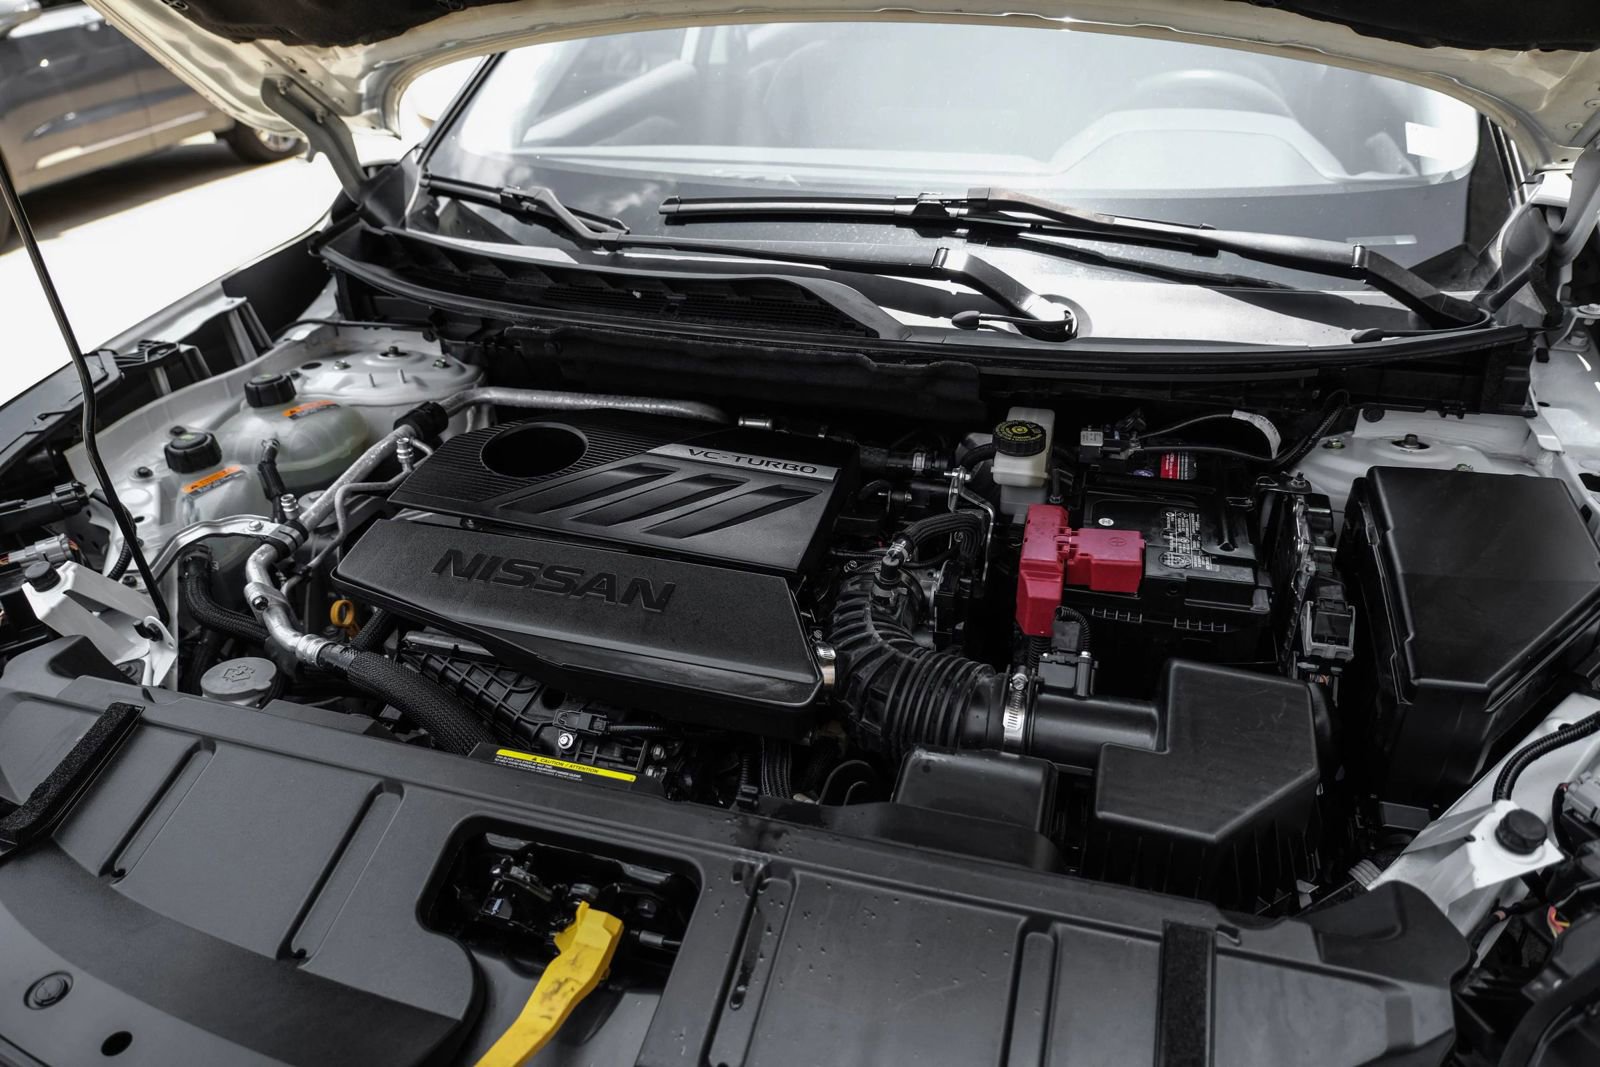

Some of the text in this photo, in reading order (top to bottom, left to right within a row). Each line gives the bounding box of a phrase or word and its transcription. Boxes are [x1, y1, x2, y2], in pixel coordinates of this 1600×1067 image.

[688, 448, 818, 475] VC-TURBO
[431, 549, 676, 613] NISSAN
[540, 758, 564, 767] CAUTION
[569, 764, 599, 773] ATTENTION
